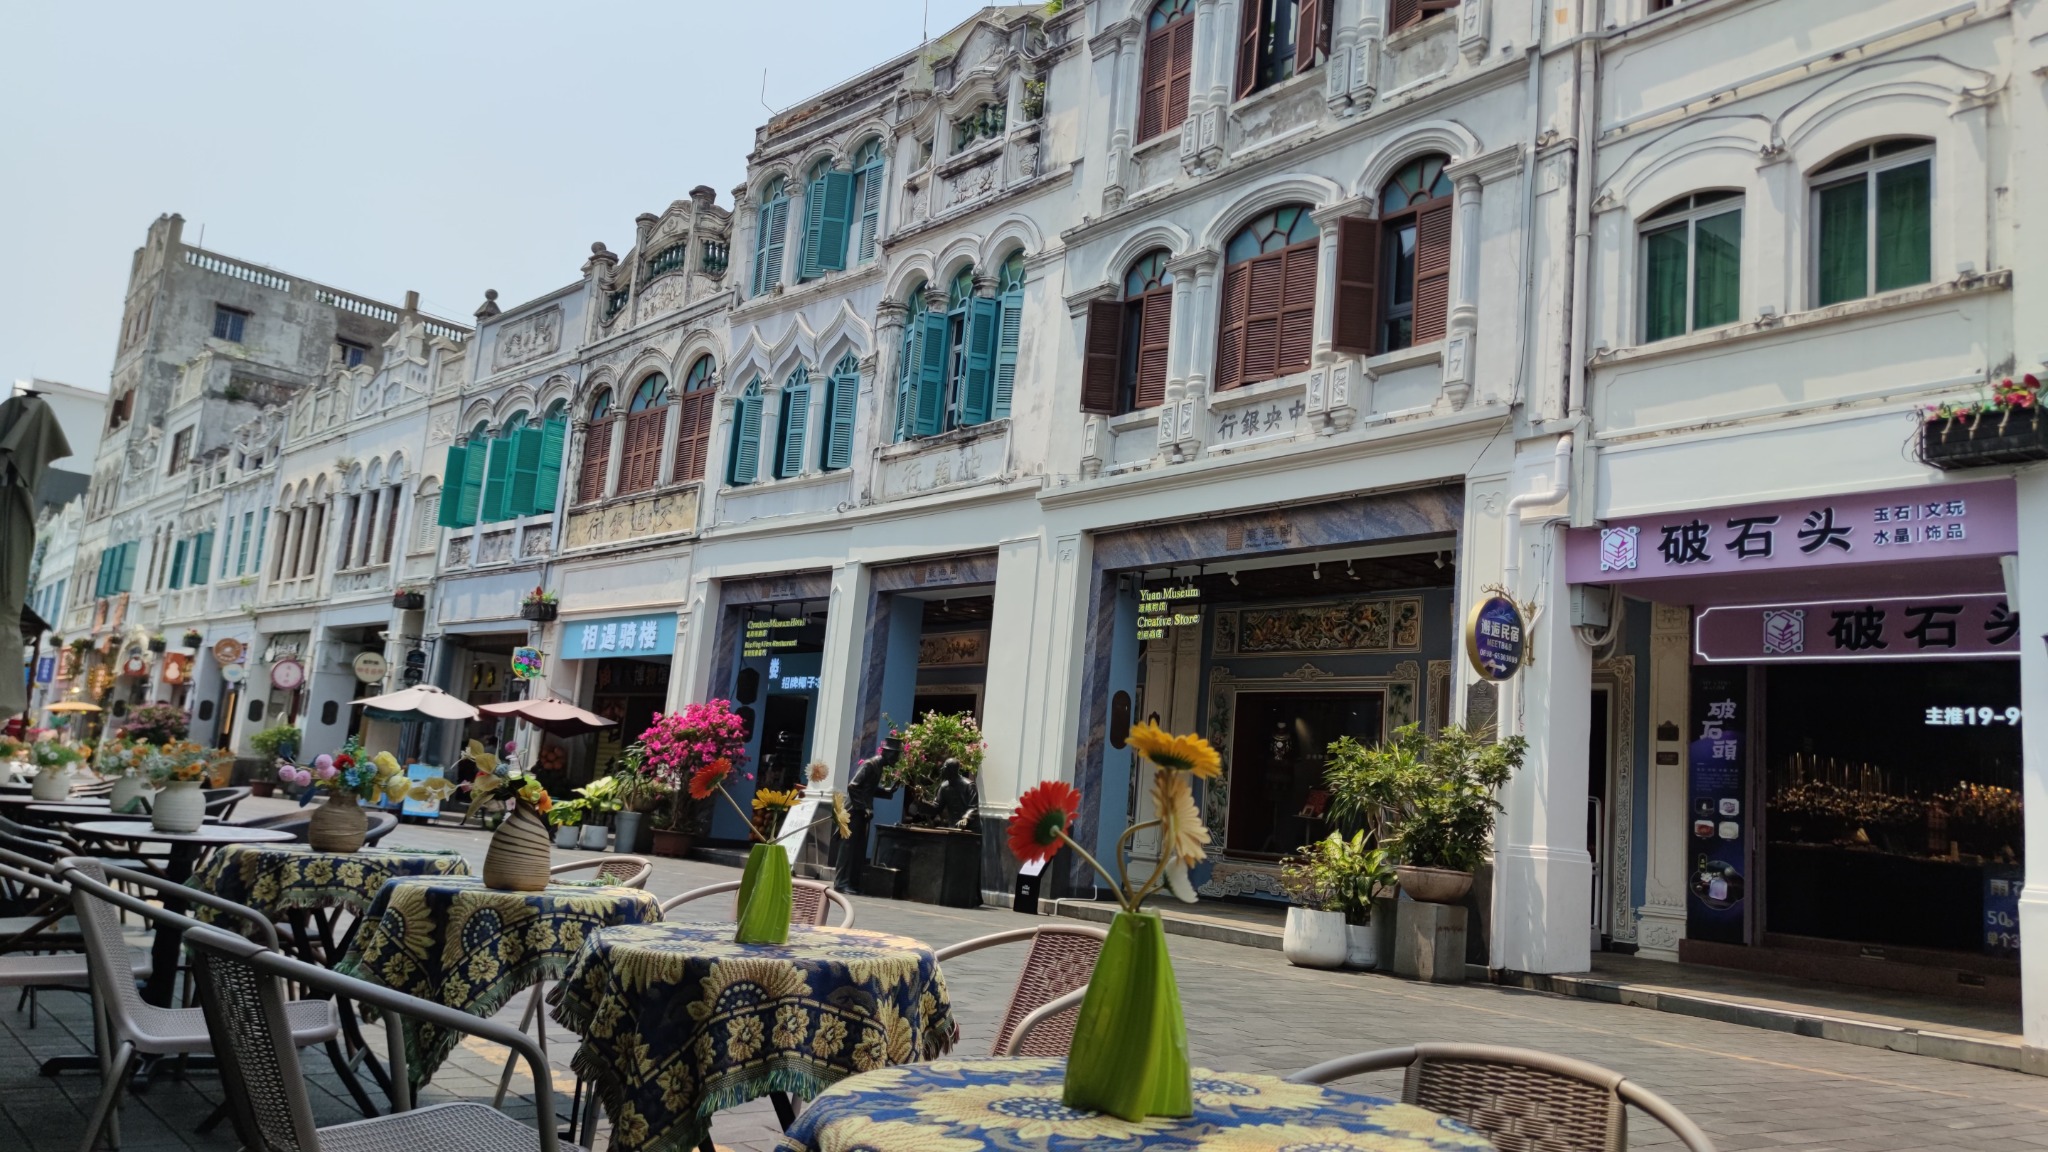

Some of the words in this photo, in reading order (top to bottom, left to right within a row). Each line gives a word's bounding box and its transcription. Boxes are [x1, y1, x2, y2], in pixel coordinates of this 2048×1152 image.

[1657, 507, 1854, 565] 破石头
[1140, 589, 1161, 601] Yuan
[1163, 587, 1200, 599] Museum
[1137, 615, 1172, 627] Creative
[1173, 613, 1200, 625] Store
[1480, 618, 1520, 643] 邂逅民宿
[581, 620, 658, 651] 相遇骑楼
[1924, 706, 2023, 725] 主推19-9
